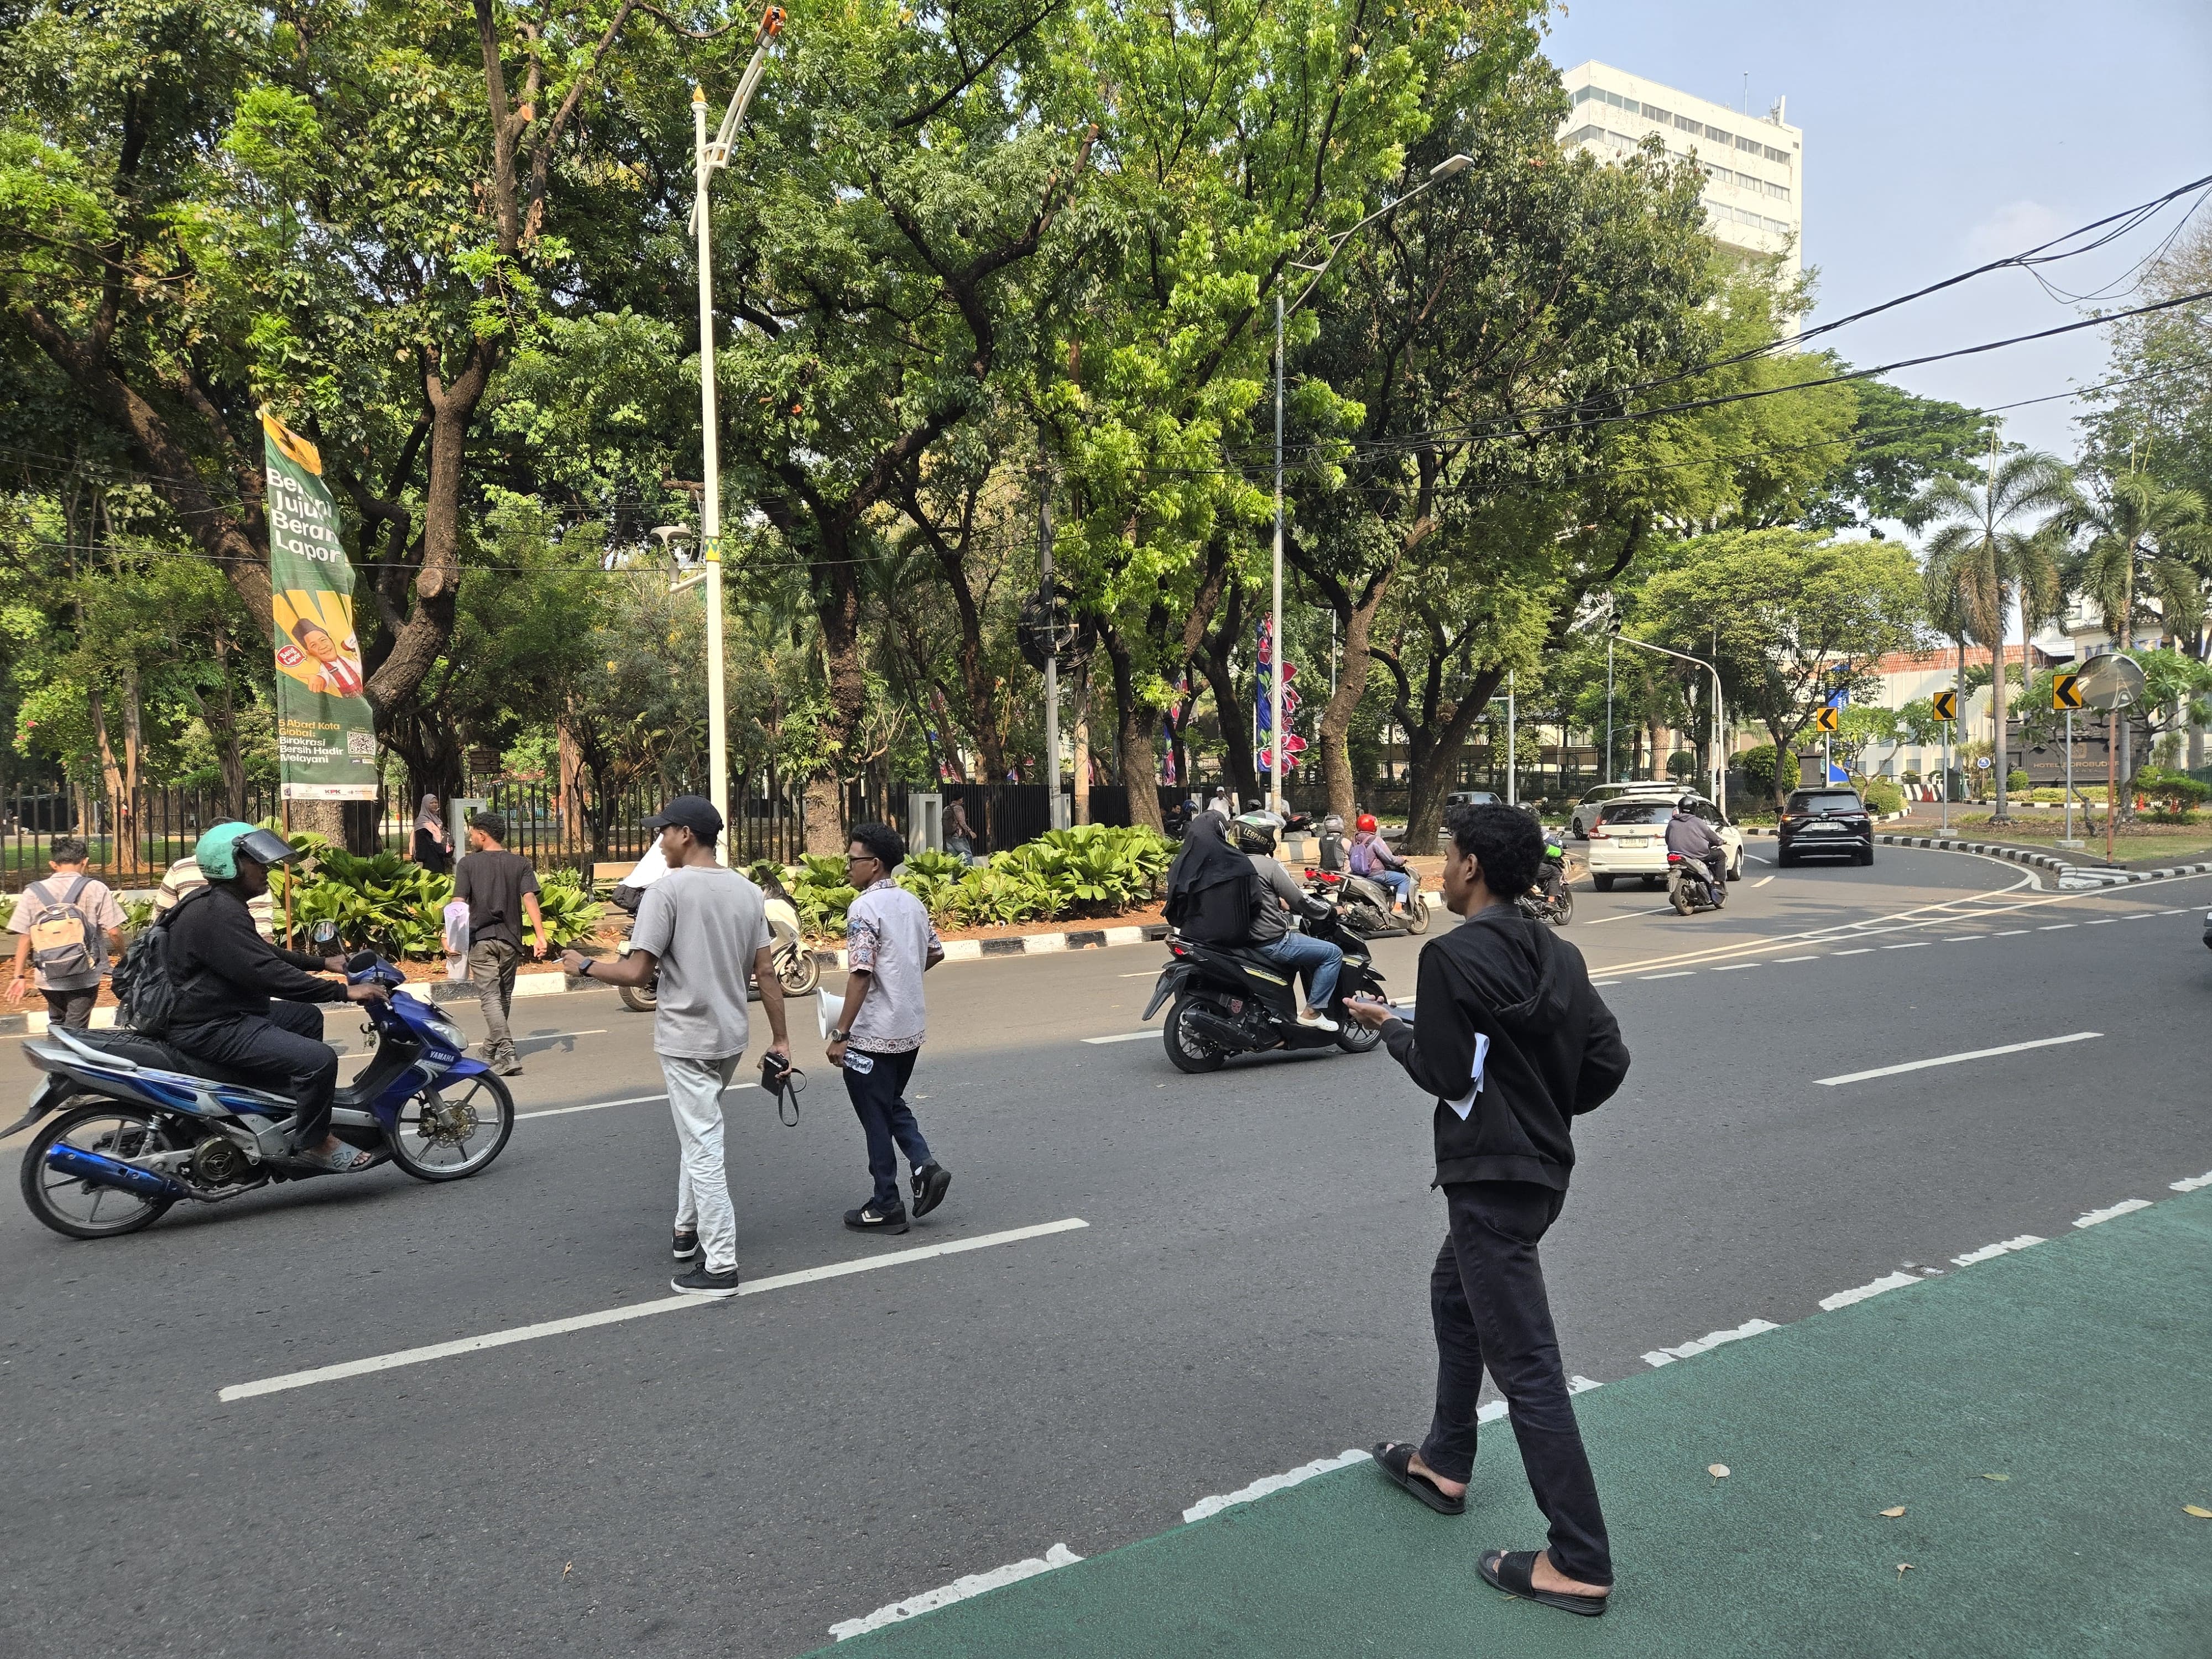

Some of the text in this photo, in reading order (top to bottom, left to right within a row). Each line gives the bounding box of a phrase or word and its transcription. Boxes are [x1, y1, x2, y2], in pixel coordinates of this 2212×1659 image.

[276, 530, 341, 563] Lapor
[280, 647, 297, 659] Bang
[284, 653, 301, 664] Lapor
[286, 719, 316, 729] Abad
[279, 728, 316, 737] Global:
[279, 737, 326, 746] Birokrasi
[280, 745, 311, 754] Bersih
[280, 754, 329, 764] Melayani
[1243, 827, 1269, 846] LEOPARD
[430, 1051, 455, 1062] YAMAHA
